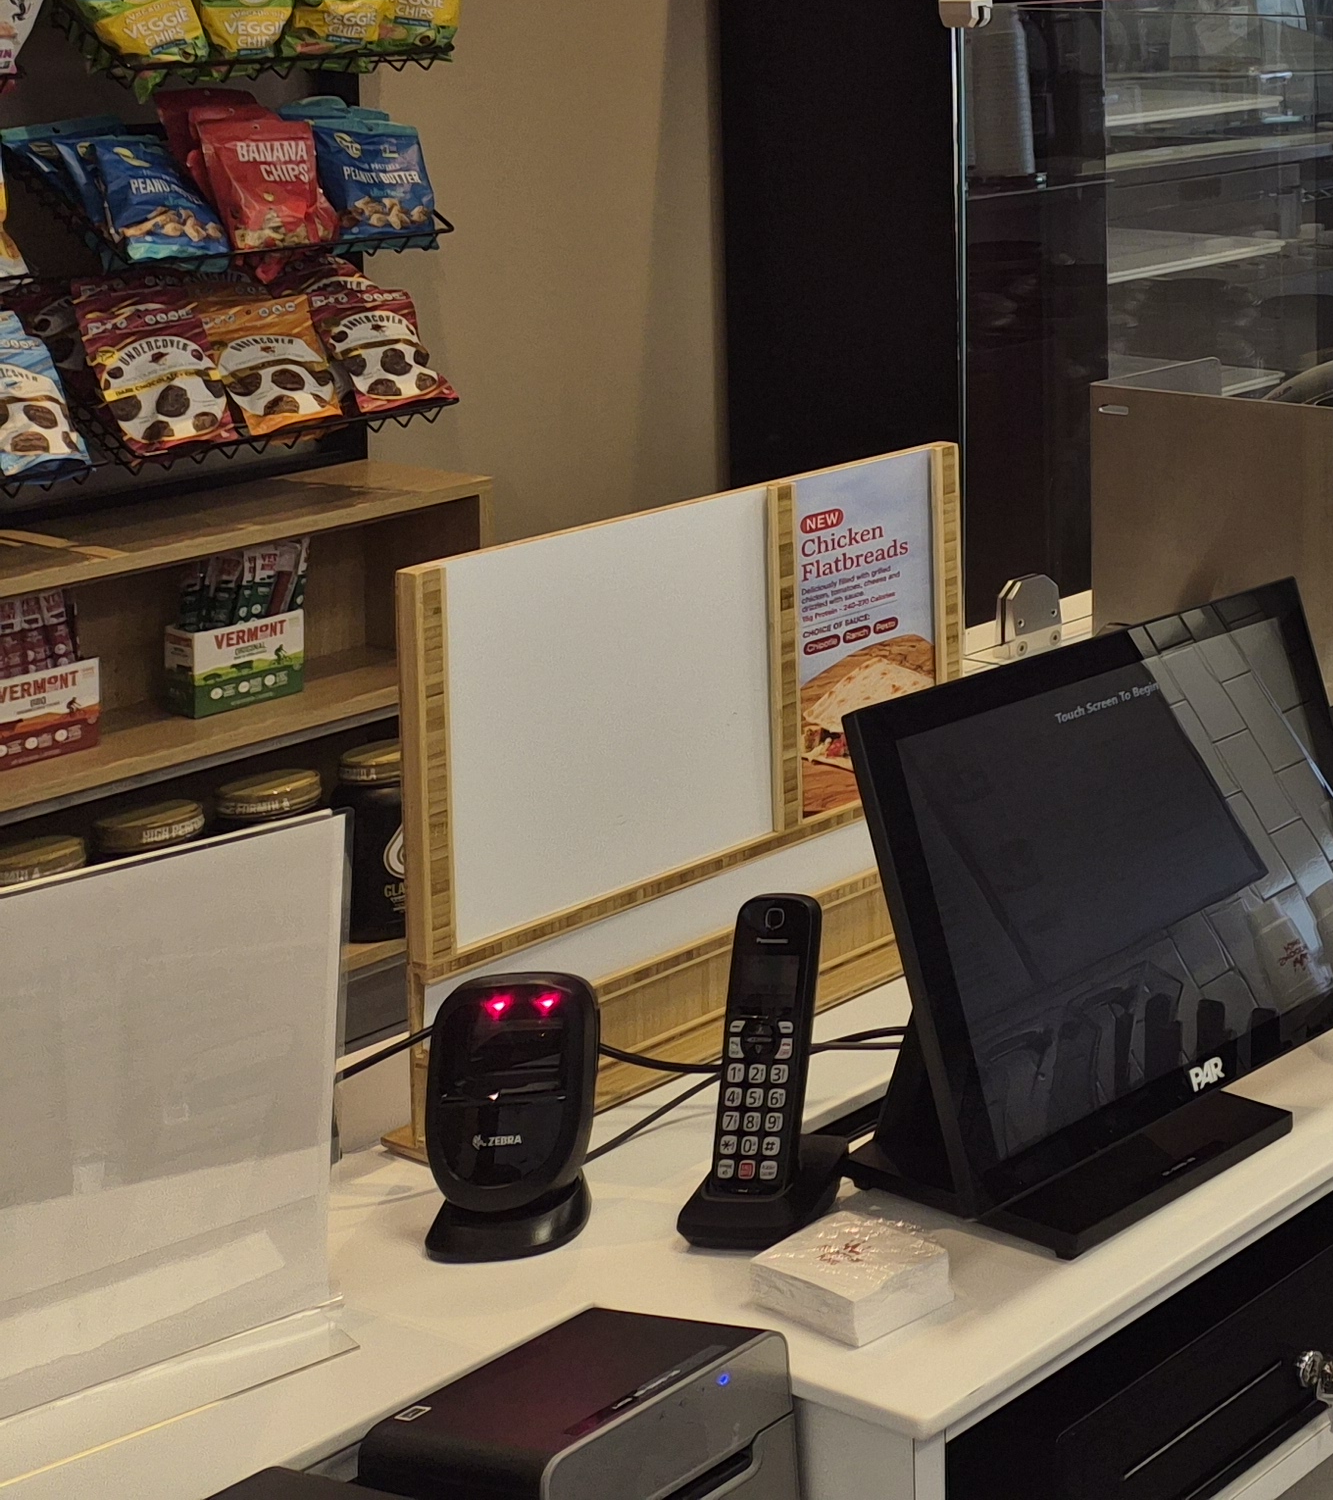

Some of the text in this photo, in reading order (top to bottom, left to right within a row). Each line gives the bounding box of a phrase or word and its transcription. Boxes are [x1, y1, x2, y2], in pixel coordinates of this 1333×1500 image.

[324, 12, 377, 26] VEGGIE
[395, 5, 435, 20] CHIPS
[123, 7, 190, 39] VEGGIE
[224, 21, 286, 35] VEGGI
[328, 25, 367, 37] CHIPS
[145, 27, 185, 47] CHIPS
[237, 35, 274, 49] CHIP
[236, 141, 308, 163] BANANA
[260, 163, 310, 183] CHIPS
[130, 177, 171, 195] PEANU
[343, 314, 403, 330] UNDERCOVER
[118, 338, 191, 367] UNDERCOVER
[806, 511, 839, 531] NEW
[801, 525, 884, 558] Chicken
[801, 539, 909, 582] Flatbreads
[801, 580, 837, 595] Deliciously
[801, 591, 829, 604] chicken,
[831, 583, 862, 596] tomatoes,
[214, 619, 287, 650] VERMONT
[802, 614, 870, 638] CHOICE OF SAUCE:
[0, 670, 79, 704] VERMONT
[1055, 682, 1159, 723] Touch Screen To Begin
[1189, 1056, 1225, 1093] PAR
[488, 1134, 522, 1147] ZEBRA
